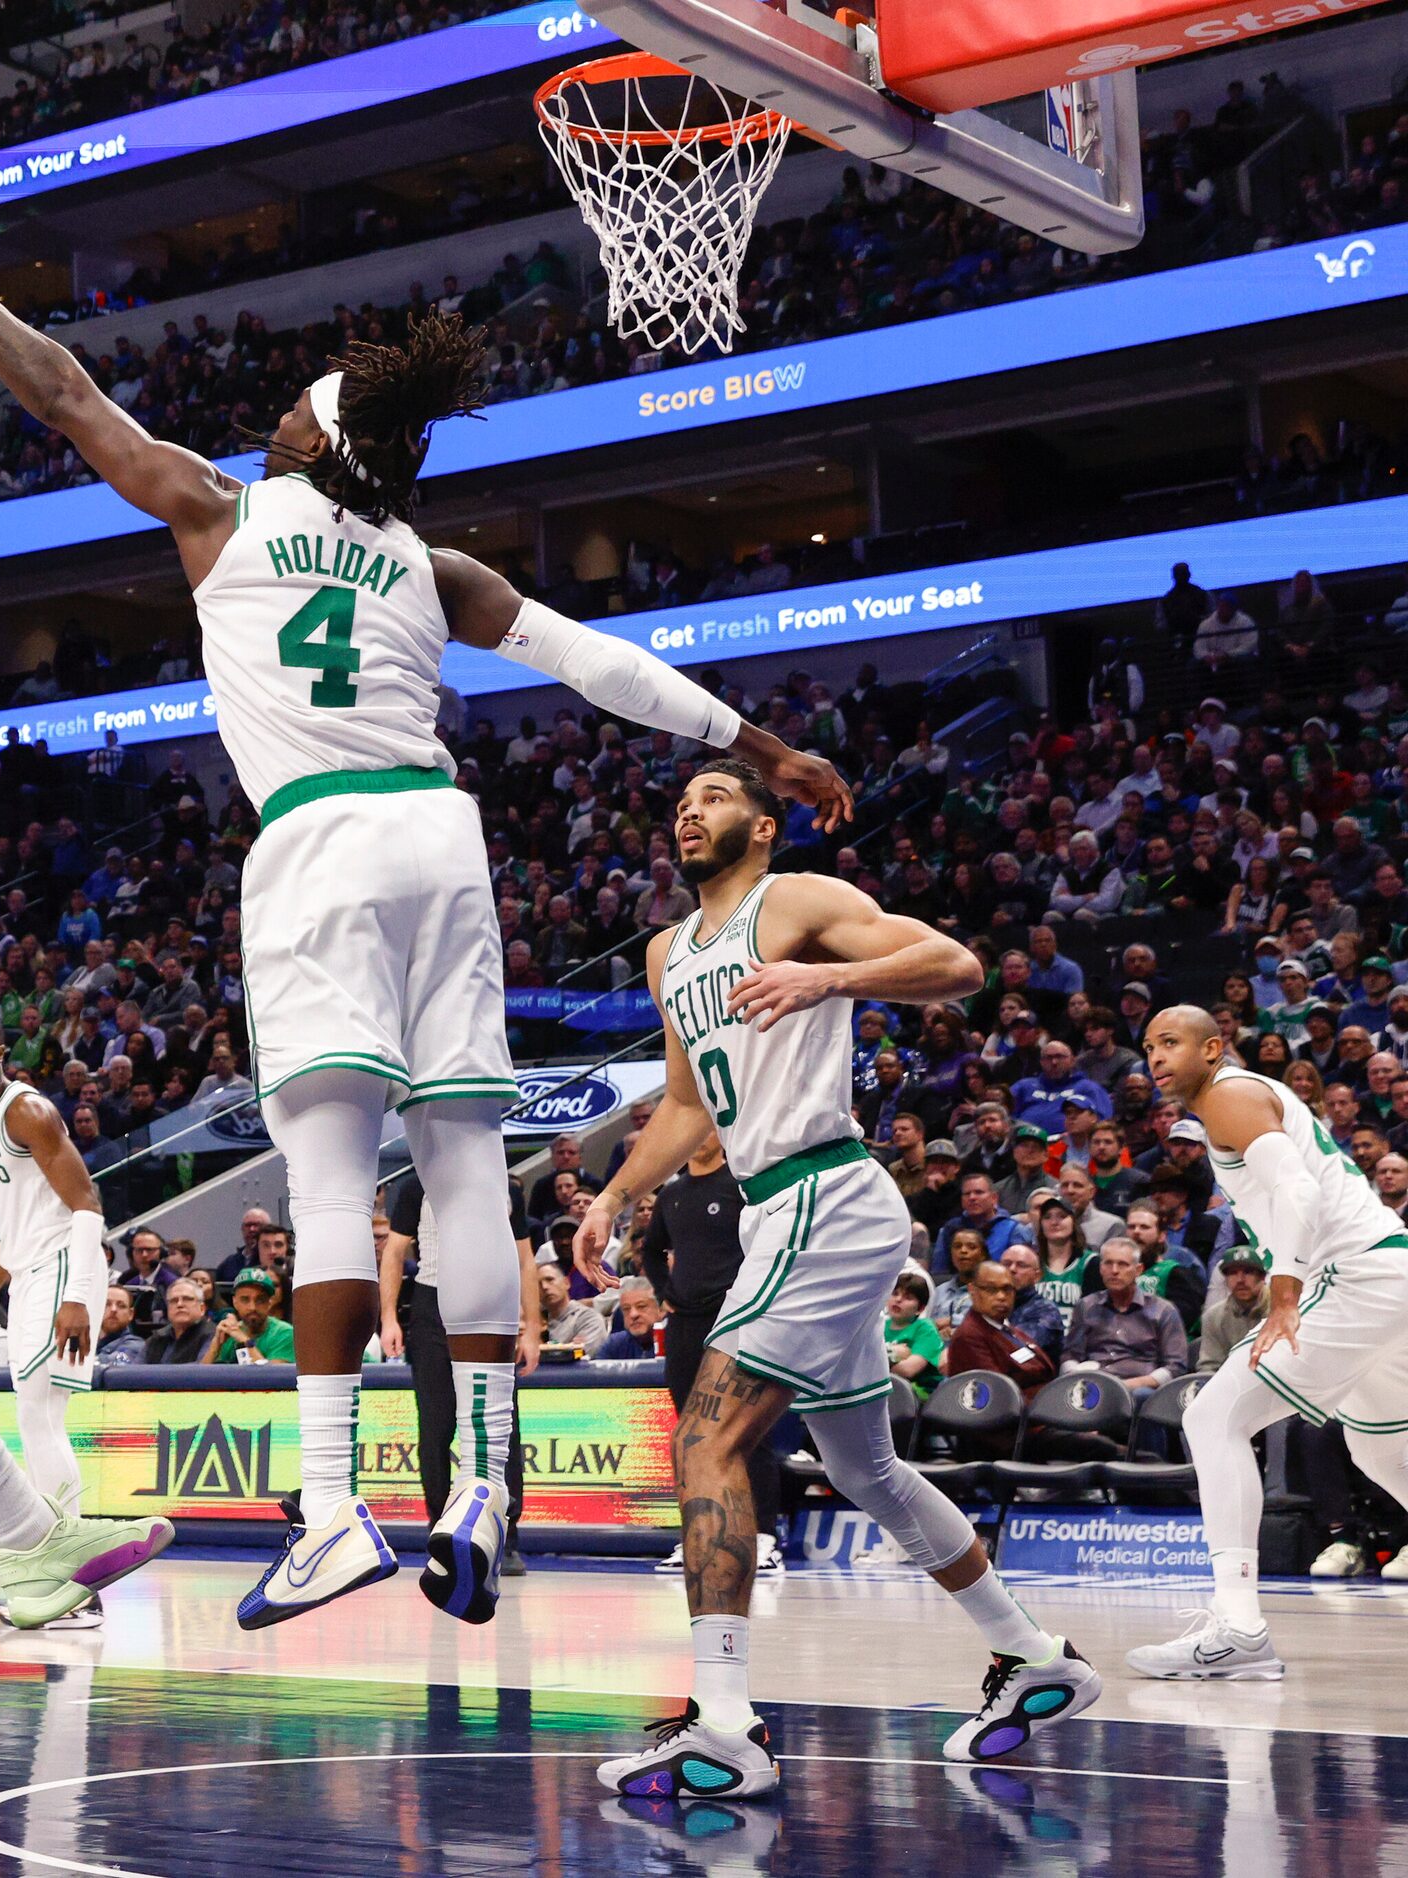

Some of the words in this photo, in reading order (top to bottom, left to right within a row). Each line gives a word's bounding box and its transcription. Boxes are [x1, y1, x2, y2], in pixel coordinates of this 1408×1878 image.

[537, 11, 583, 41] Get
[26, 149, 75, 178] Your
[79, 134, 127, 164] Seat
[638, 385, 716, 417] Score
[724, 362, 806, 401] BIGW
[266, 533, 409, 598] HOLIDAY
[650, 625, 695, 650] Get
[701, 614, 770, 644] Fresh
[778, 603, 846, 632] From
[852, 593, 915, 620] Your
[921, 581, 983, 611] Seat
[277, 585, 361, 708] 4
[36, 716, 88, 739] Fresh
[93, 708, 146, 732] From
[149, 701, 198, 723] Your
[725, 930, 745, 945] PRINT
[727, 917, 748, 935] VISTA
[511, 1079, 594, 1120] Ford
[698, 1046, 737, 1128] 0
[548, 1438, 628, 1475] LAW
[1076, 1546, 1149, 1565] Medical
